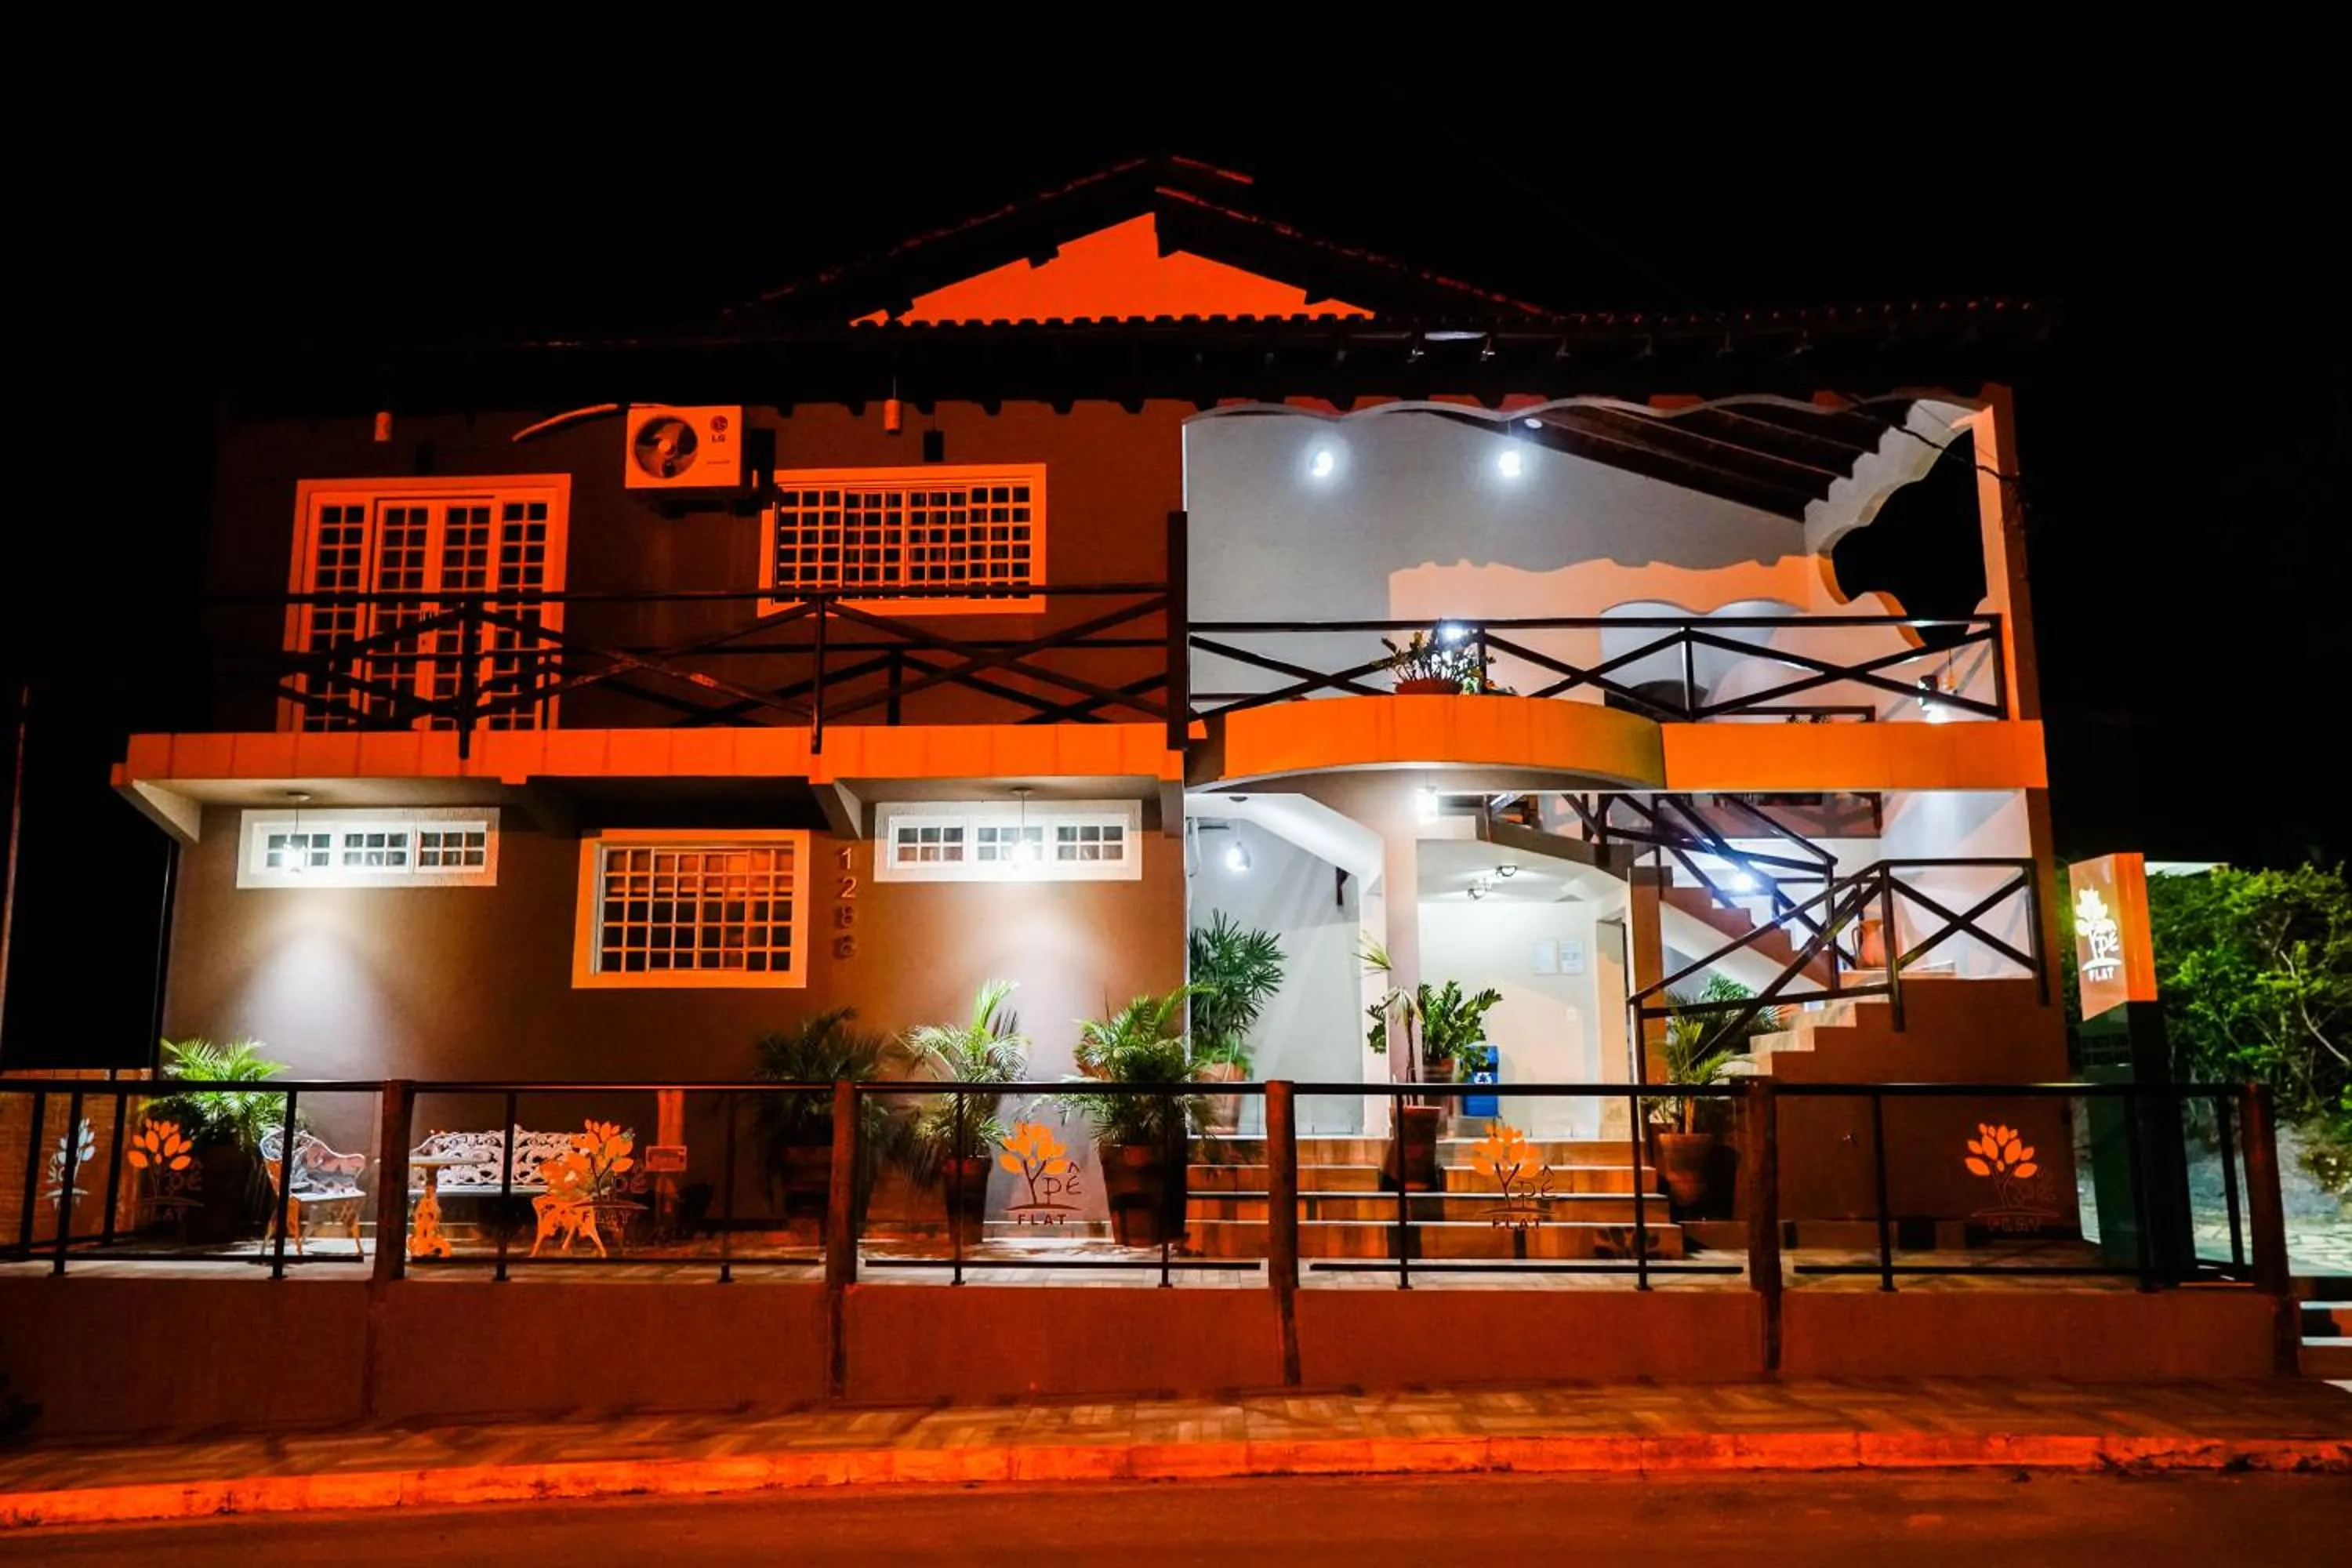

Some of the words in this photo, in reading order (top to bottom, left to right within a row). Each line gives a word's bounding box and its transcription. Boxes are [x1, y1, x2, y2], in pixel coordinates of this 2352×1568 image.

[711, 434, 726, 443] LG
[2089, 966, 2114, 983] FLAT
[1018, 1213, 1067, 1225] FLAT
[1492, 1218, 1541, 1230] FLAT
